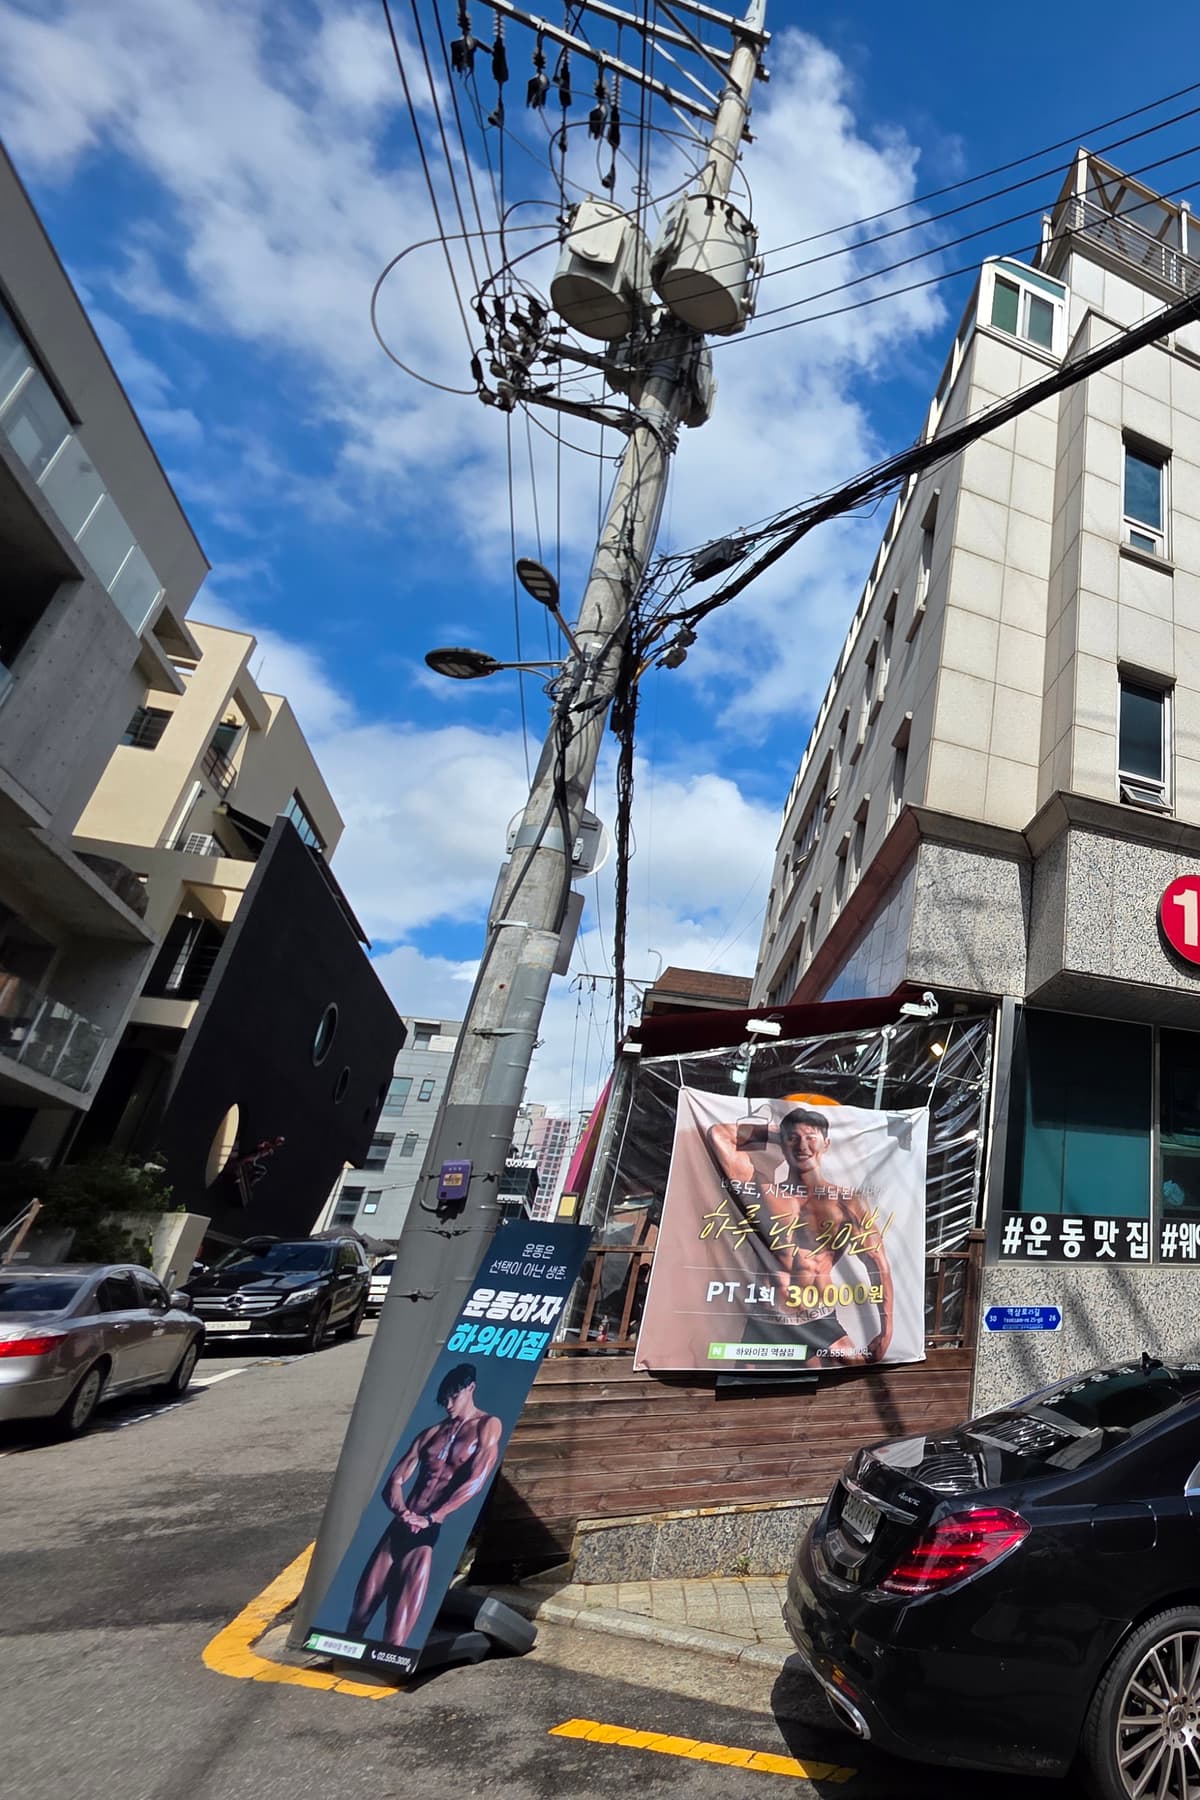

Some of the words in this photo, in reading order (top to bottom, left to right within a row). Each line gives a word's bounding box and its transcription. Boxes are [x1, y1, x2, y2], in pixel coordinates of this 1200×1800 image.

[765, 1183, 809, 1199] 시간도
[699, 1200, 761, 1250] 하루
[522, 1243, 555, 1260] 운동은
[489, 1260, 521, 1276] 선택이
[522, 1263, 546, 1278] 아닌
[706, 1281, 741, 1303] PT
[744, 1283, 776, 1306] 1회
[462, 1288, 564, 1325] 운동하자
[447, 1323, 550, 1361] 하와이짐
[735, 1348, 768, 1357] 하와이짐
